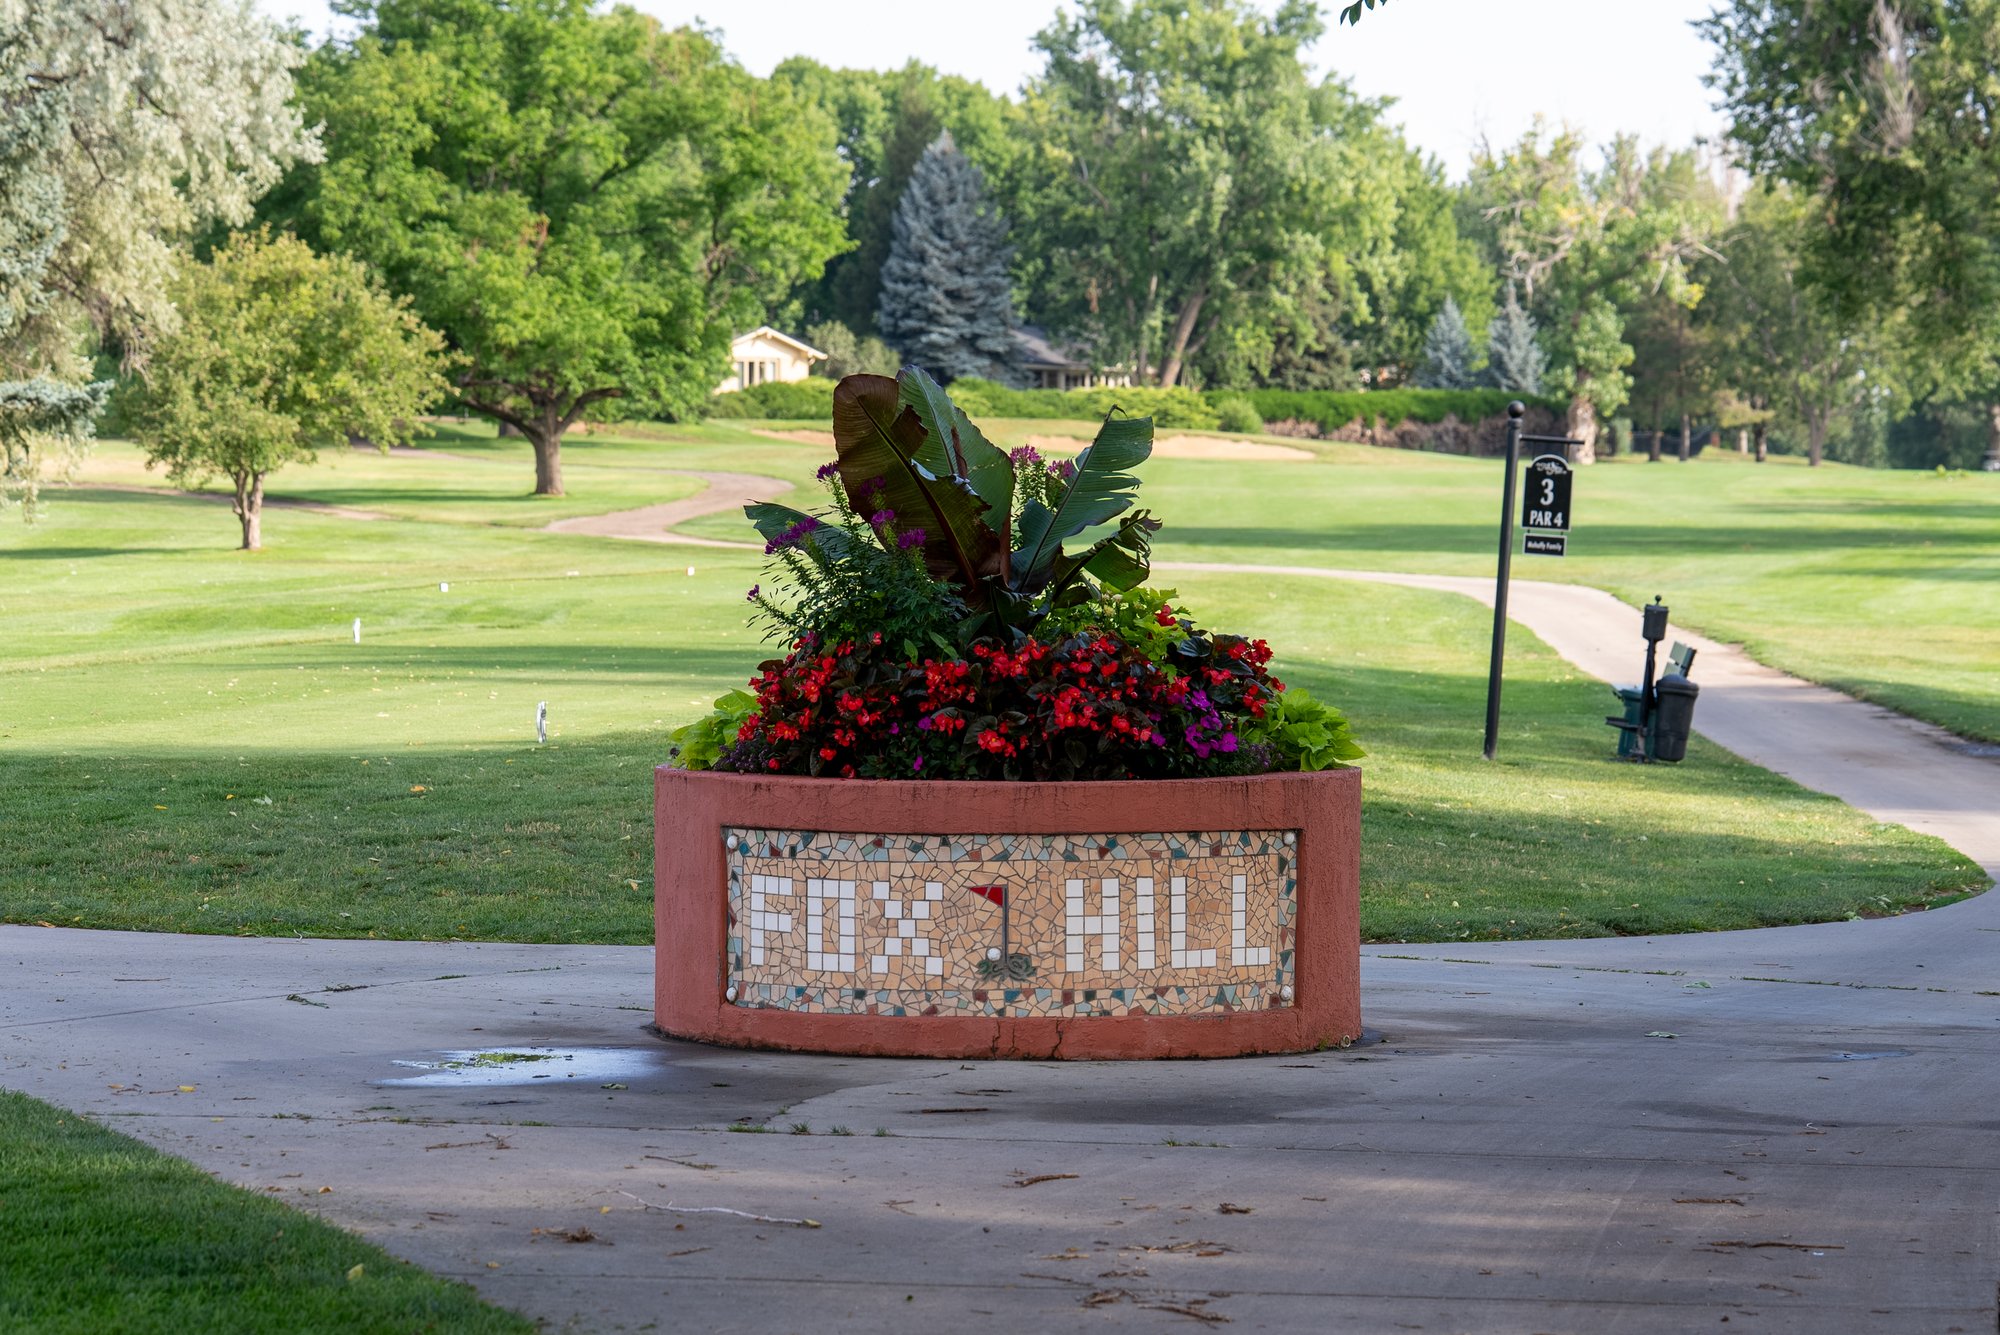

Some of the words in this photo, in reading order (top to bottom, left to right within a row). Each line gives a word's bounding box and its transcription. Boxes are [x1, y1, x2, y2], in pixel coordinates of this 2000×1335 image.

[1540, 478, 1554, 506] 3
[1530, 510, 1552, 526] PAR
[1553, 512, 1563, 527] 4
[750, 874, 944, 976] FOX
[1065, 874, 1271, 972] HILL
